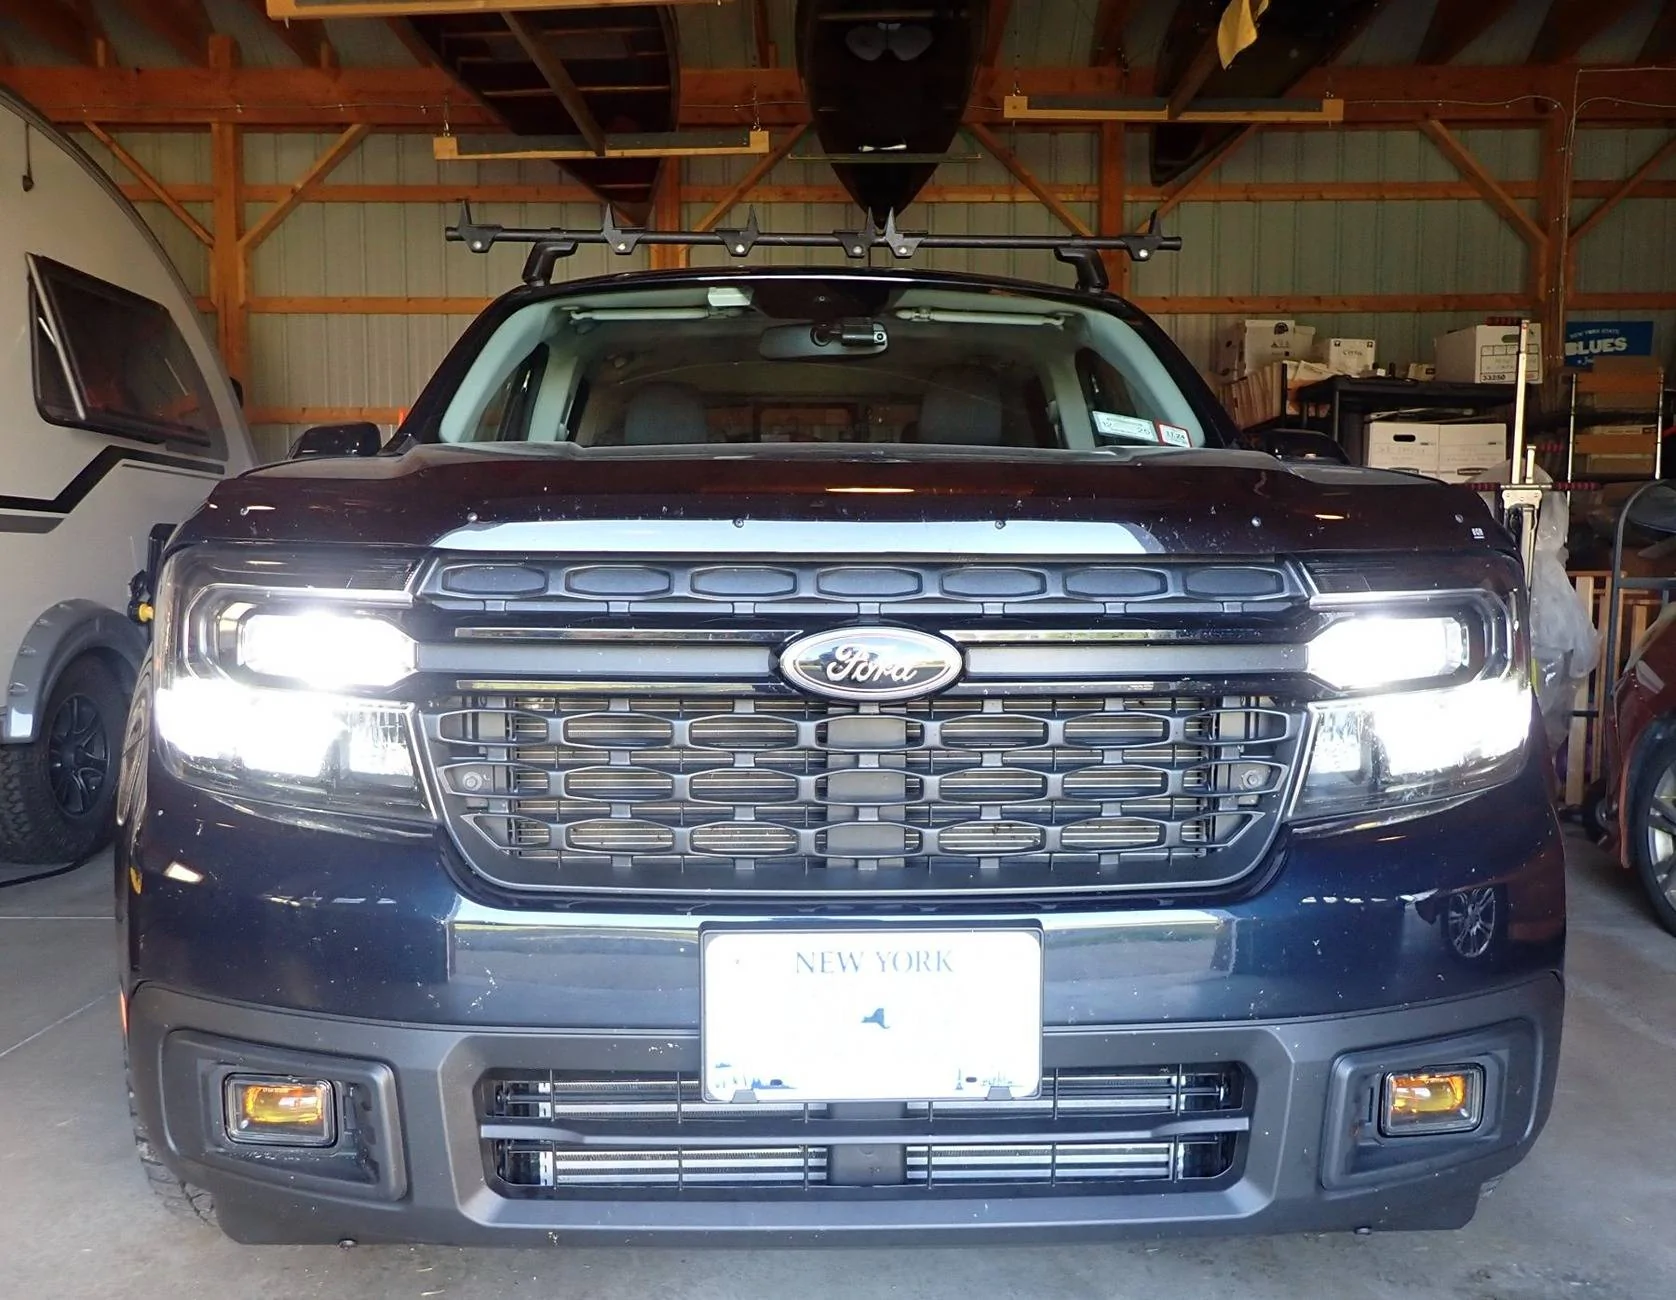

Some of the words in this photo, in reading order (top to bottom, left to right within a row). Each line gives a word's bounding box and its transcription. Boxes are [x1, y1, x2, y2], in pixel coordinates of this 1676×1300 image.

[1564, 337, 1628, 356] BLUES
[826, 643, 918, 682] Ford
[796, 950, 865, 973] NEW
[875, 950, 954, 973] YORK
